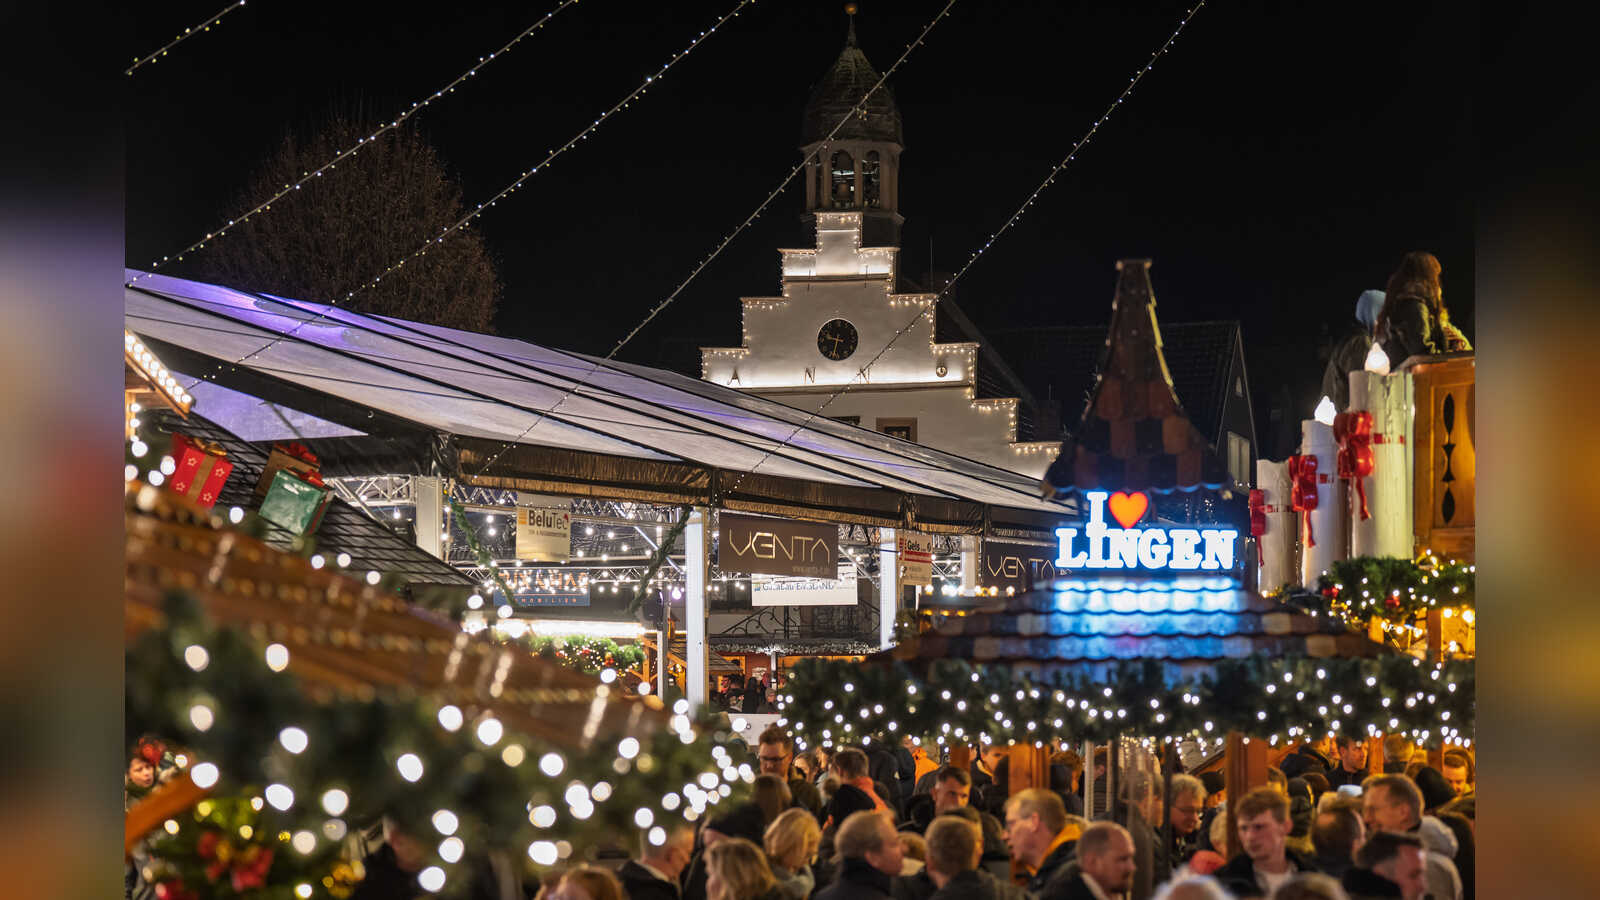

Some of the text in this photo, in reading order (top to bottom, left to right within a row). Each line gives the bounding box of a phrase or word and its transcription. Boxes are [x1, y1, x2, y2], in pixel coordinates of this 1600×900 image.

[1087, 491, 1108, 537] I
[729, 528, 830, 566] VENTA
[1055, 527, 1238, 570] LINGEN
